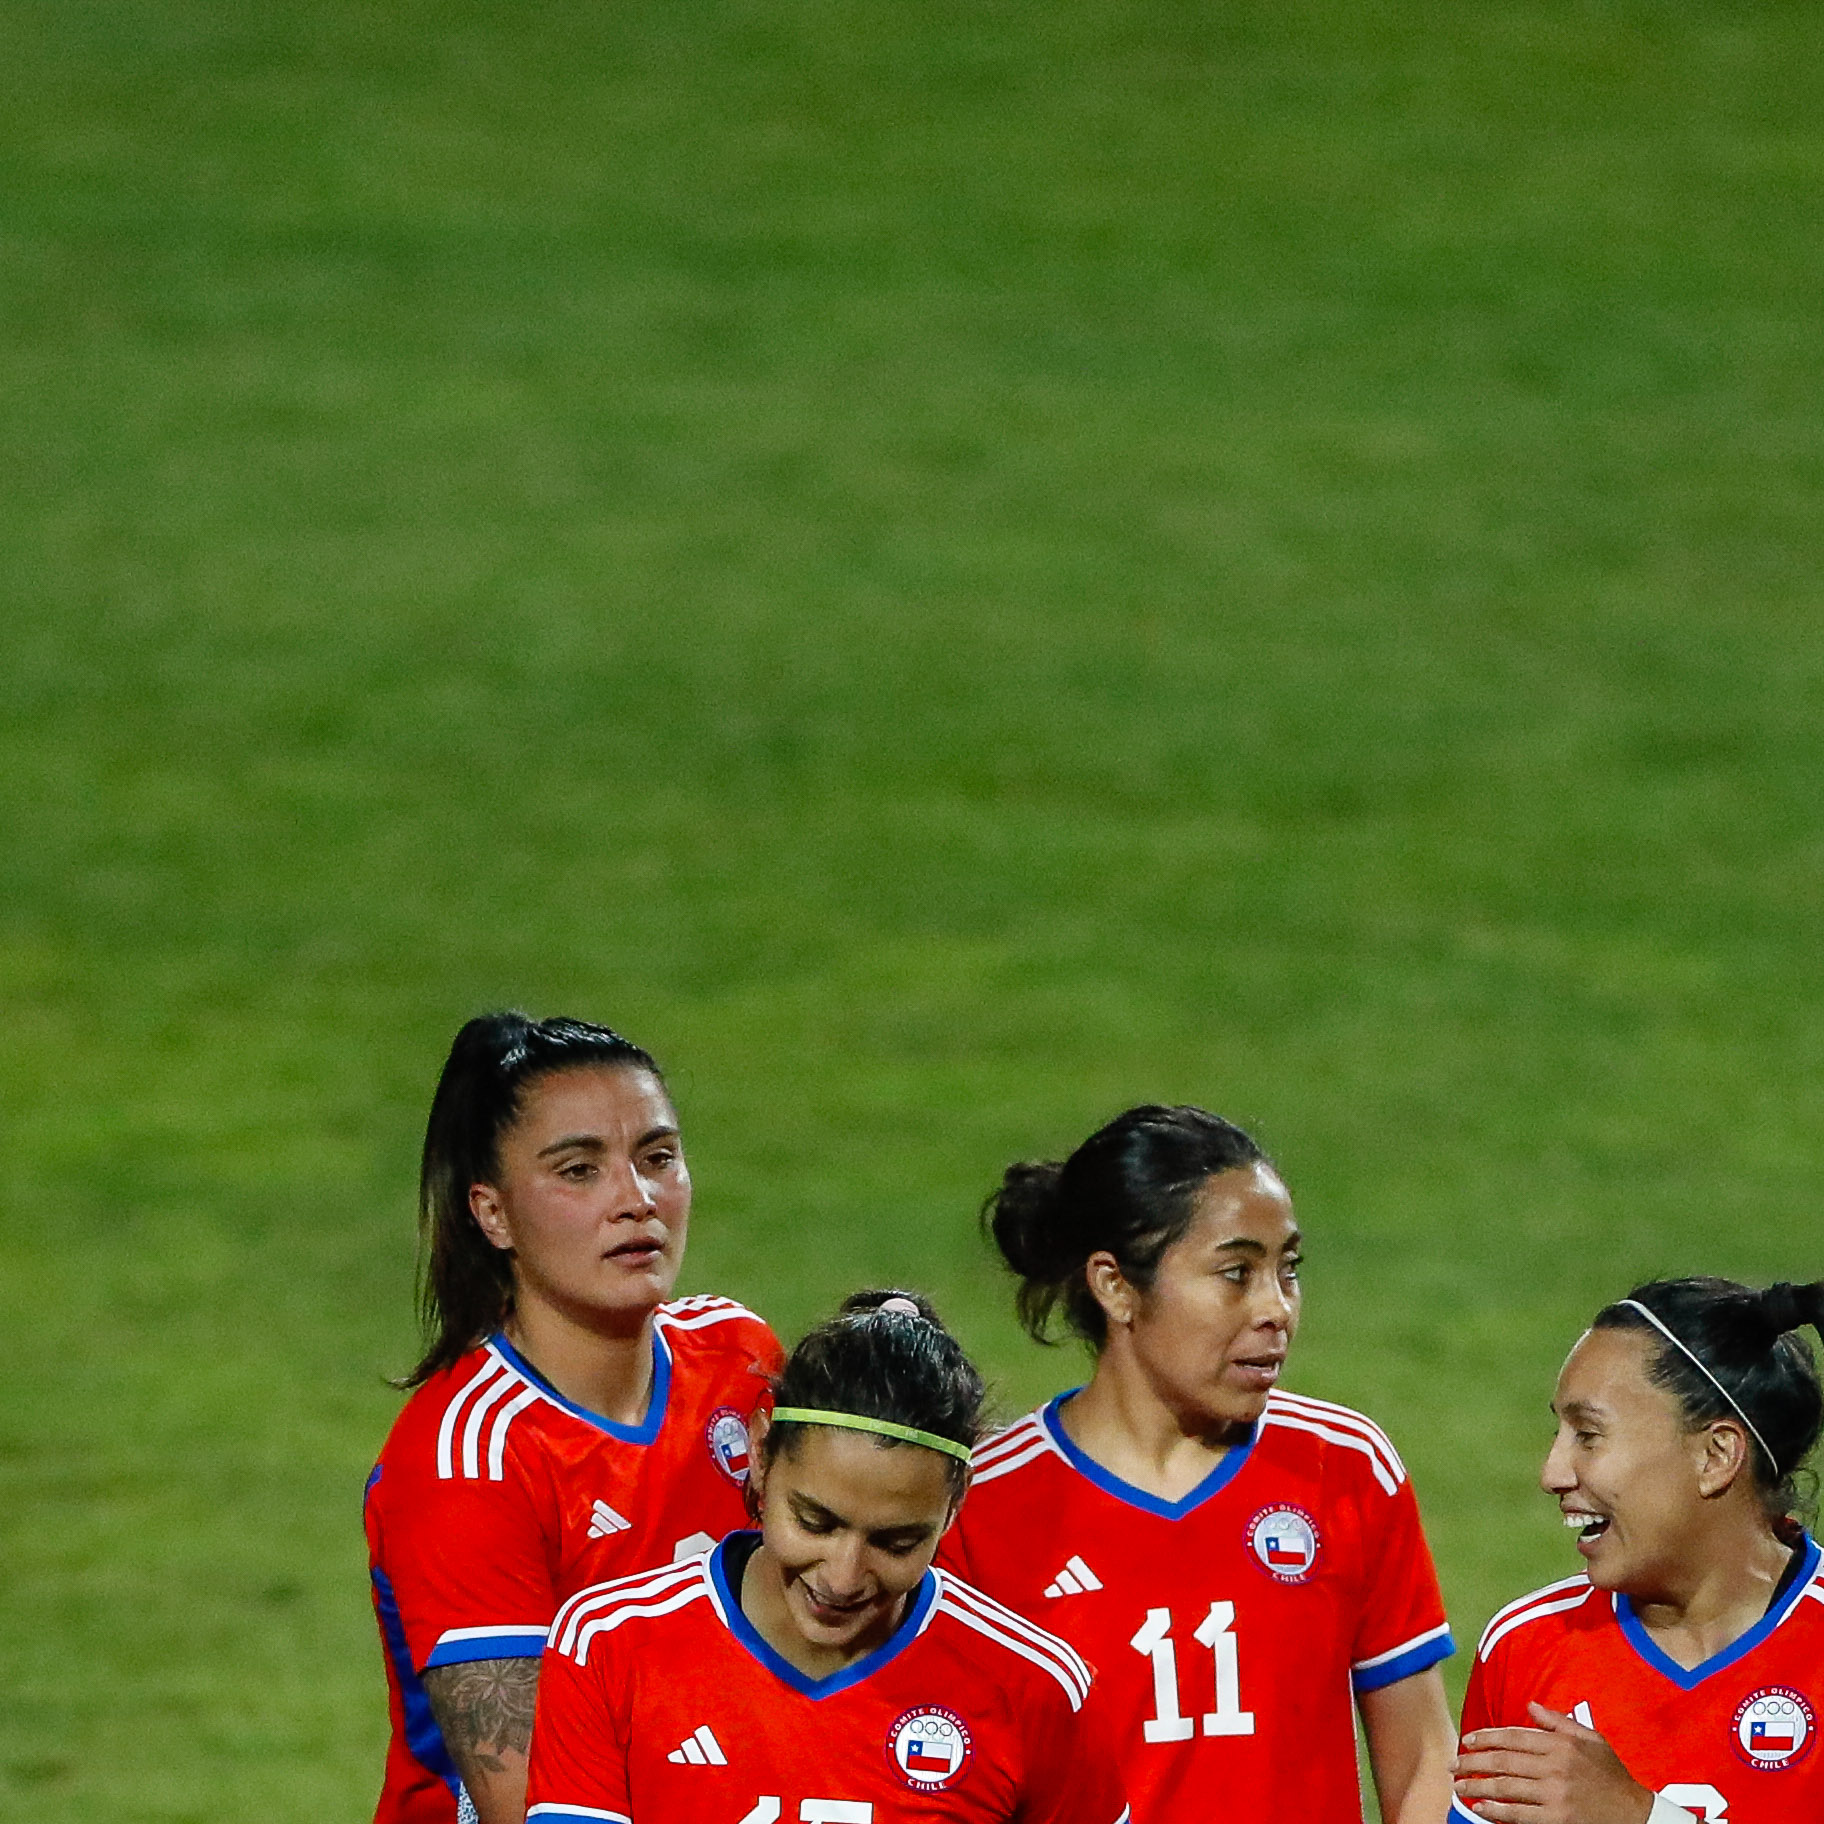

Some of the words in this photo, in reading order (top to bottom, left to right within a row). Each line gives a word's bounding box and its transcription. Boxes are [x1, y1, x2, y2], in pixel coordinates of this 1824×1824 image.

[1131, 1600, 1256, 1744] 11
[1734, 1689, 1766, 1722] COMITE
[1771, 1687, 1813, 1721] OLIMPICO
[890, 1707, 924, 1737] COMITE
[929, 1707, 971, 1744] OLIMPICO
[1751, 1758, 1790, 1770] CHILE
[907, 1778, 947, 1791] CHILE
